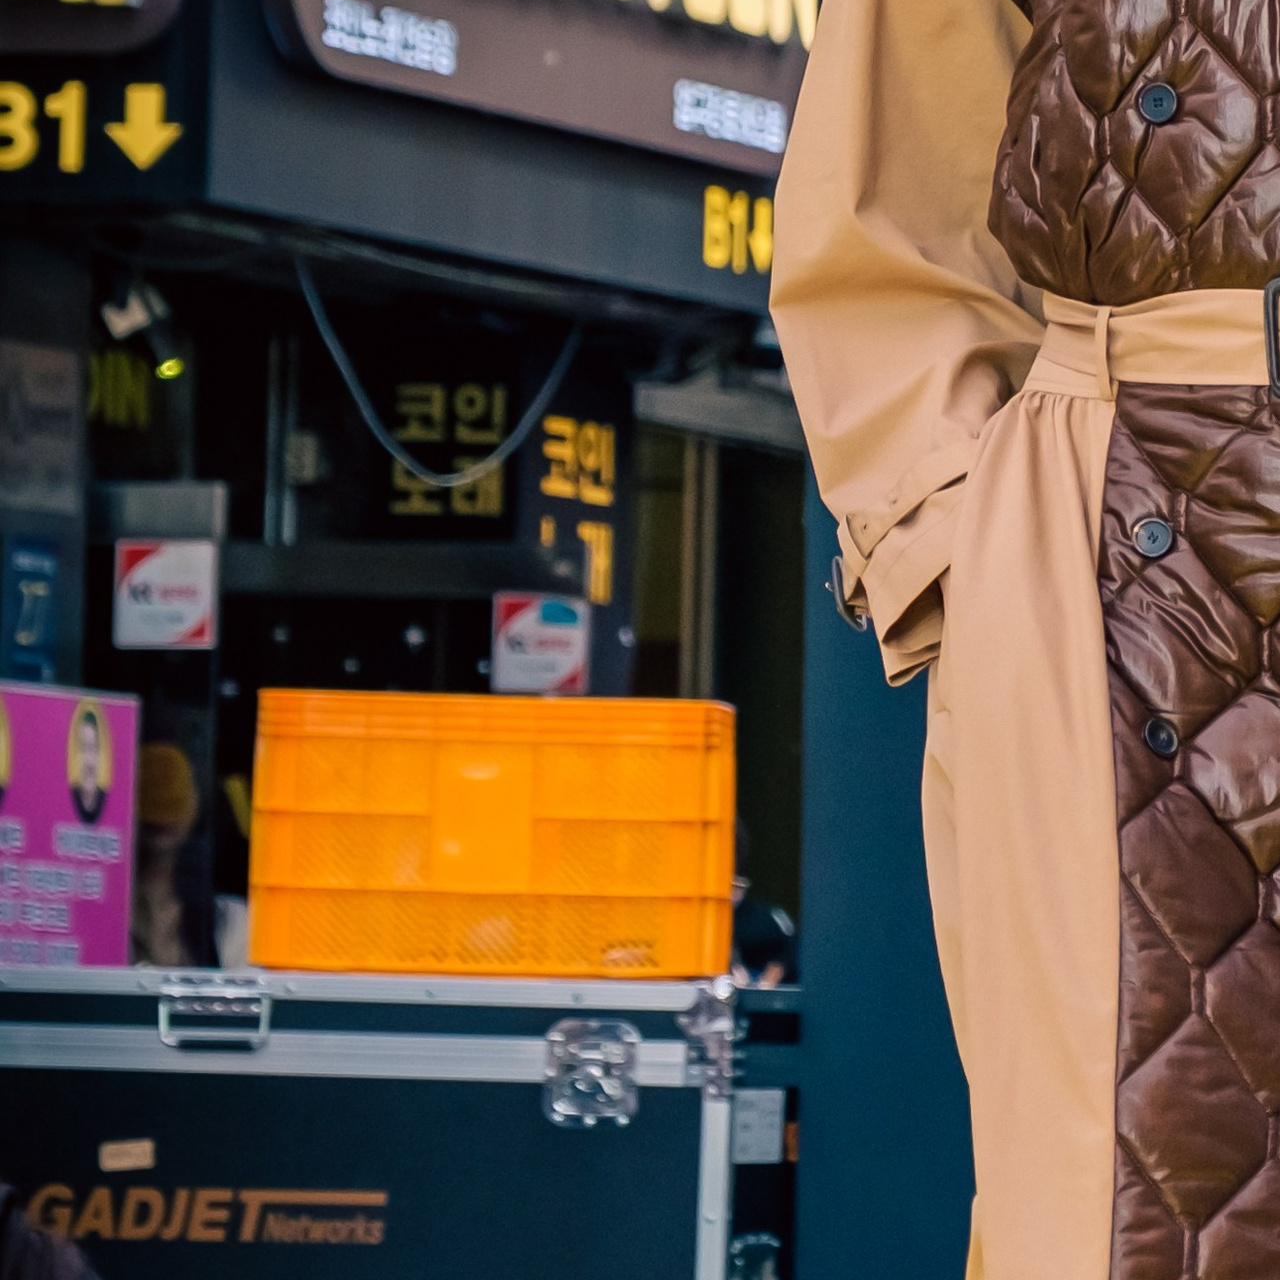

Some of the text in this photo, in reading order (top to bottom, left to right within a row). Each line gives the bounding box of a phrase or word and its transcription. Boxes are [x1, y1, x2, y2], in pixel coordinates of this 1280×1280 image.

[703, 184, 750, 275] B1
[394, 382, 508, 444] 코인
[540, 415, 616, 507] 코인
[27, 1183, 388, 1243] GADJET
